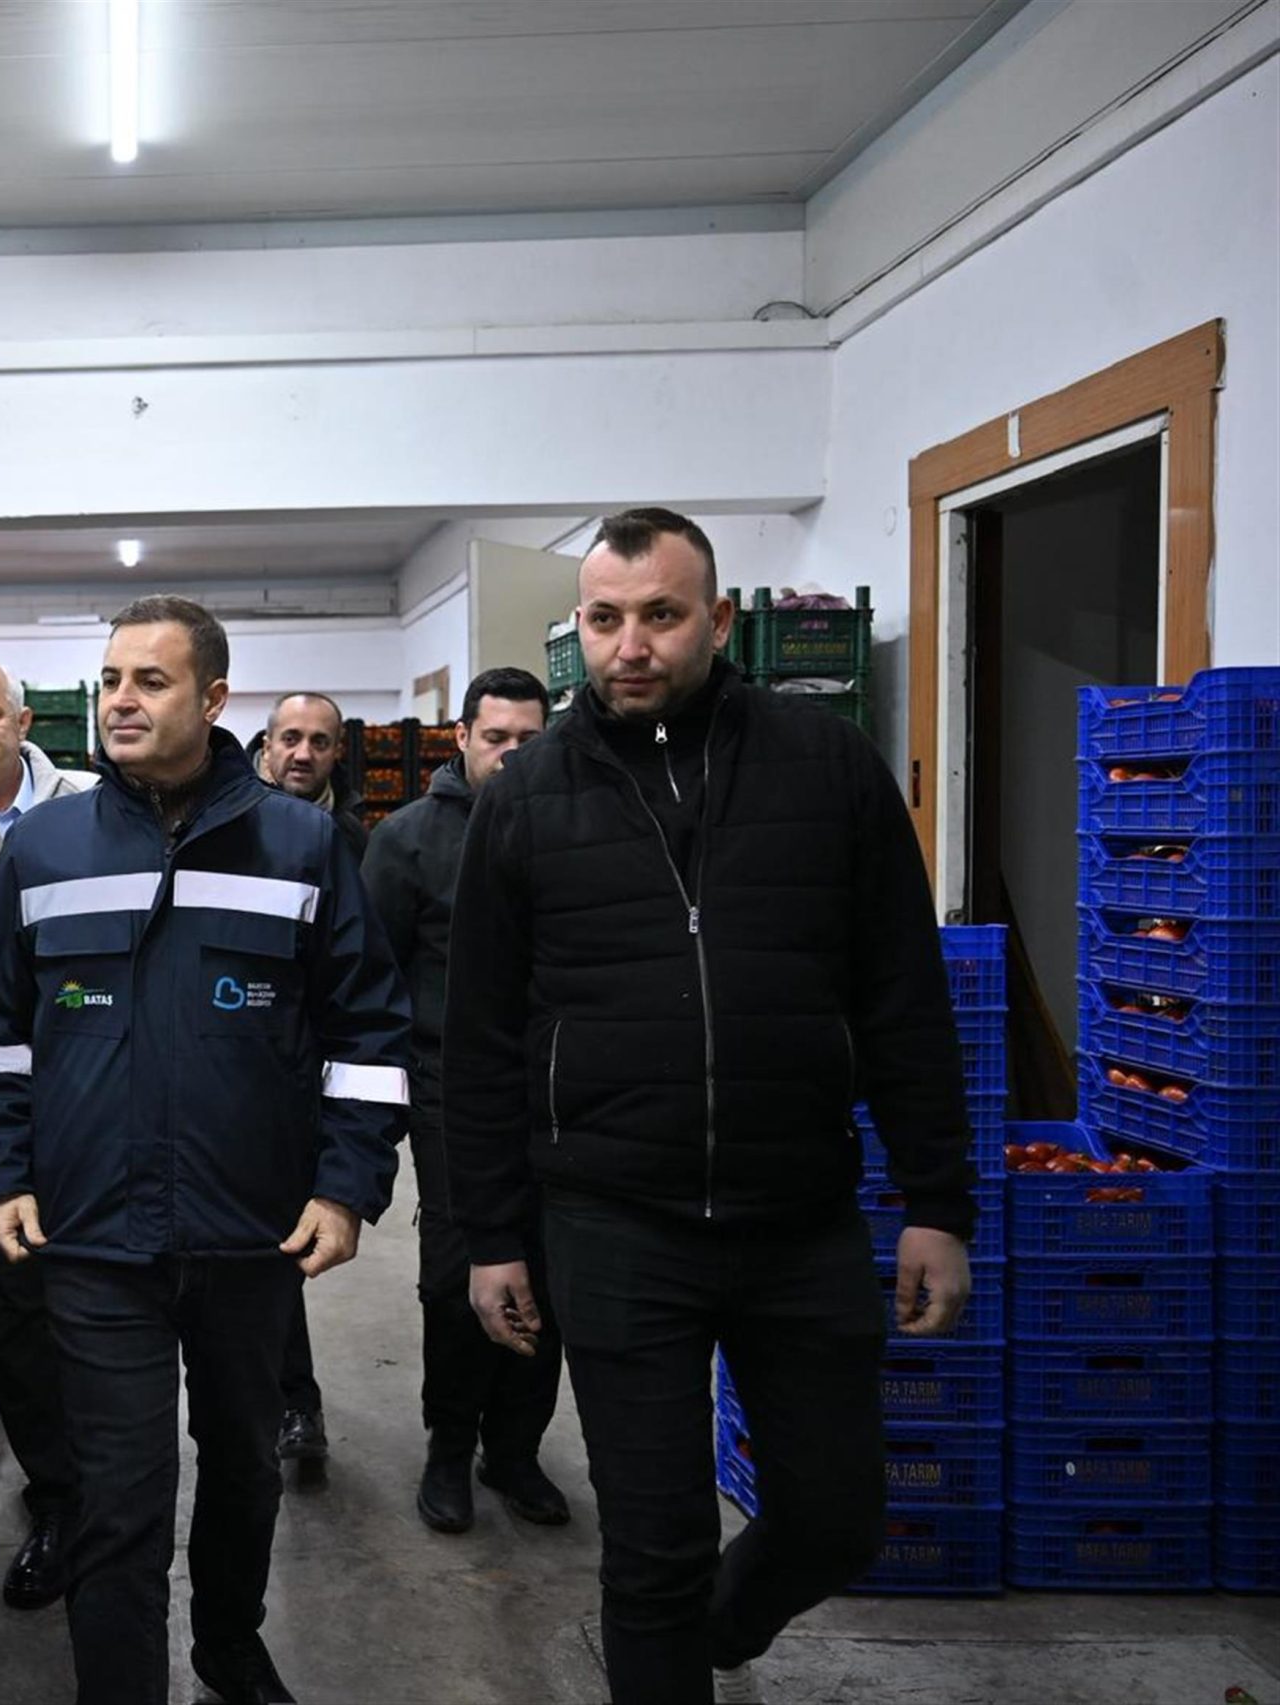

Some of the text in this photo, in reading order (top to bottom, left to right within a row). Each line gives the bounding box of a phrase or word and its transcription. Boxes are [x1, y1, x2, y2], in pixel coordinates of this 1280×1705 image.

[903, 1380, 942, 1396] TARIM
[884, 1462, 942, 1480] FA TARIM
[903, 1544, 942, 1561] TARIM
